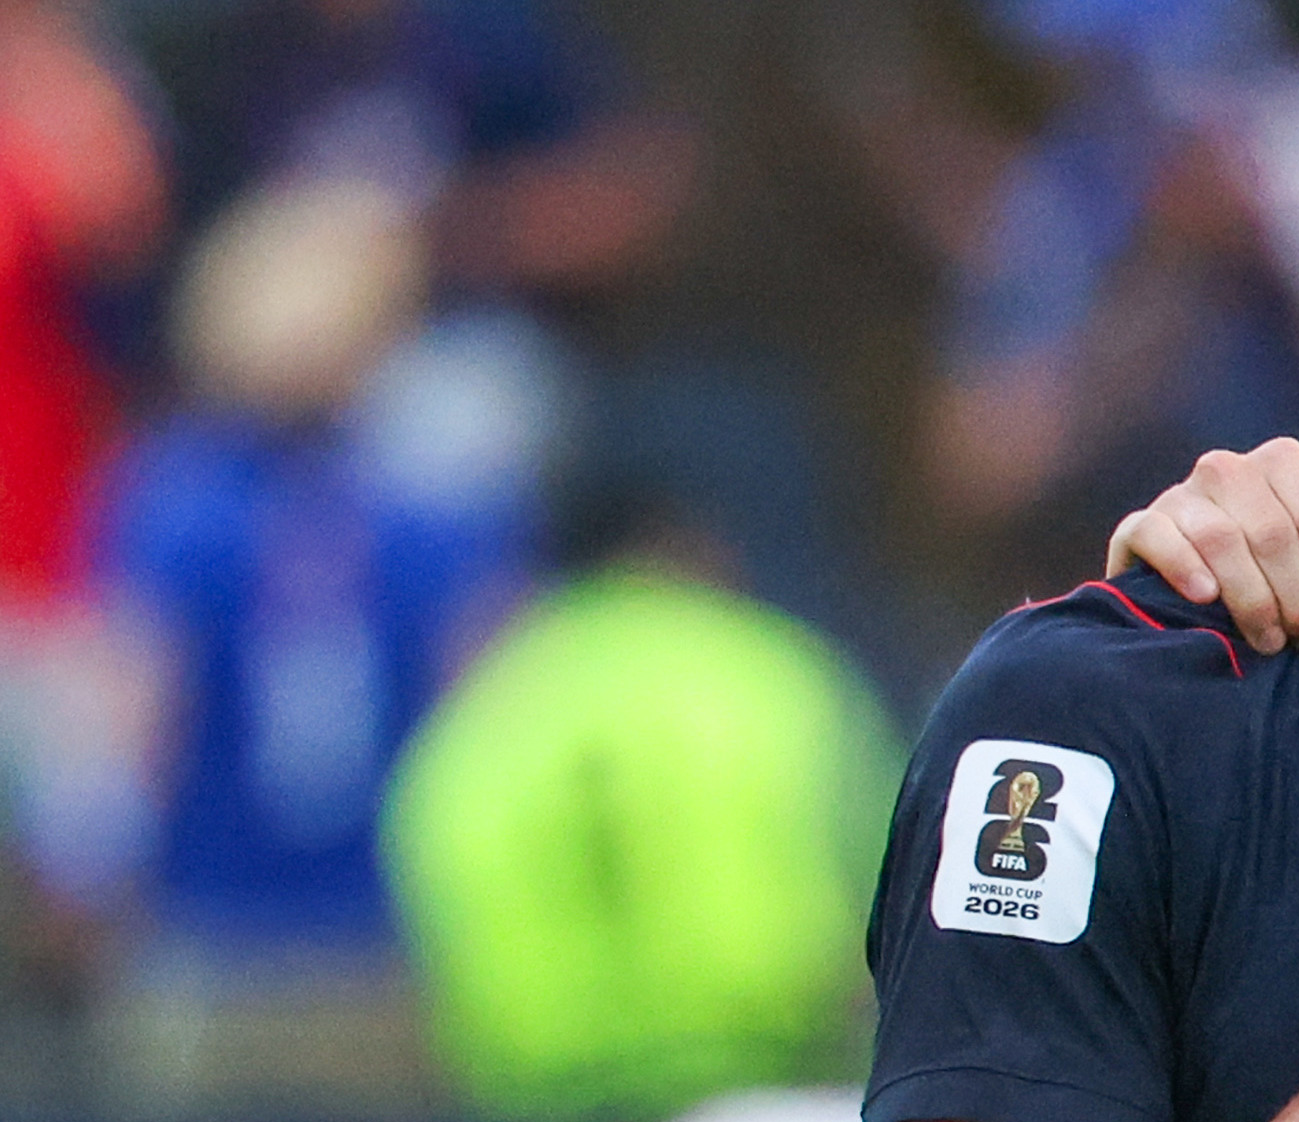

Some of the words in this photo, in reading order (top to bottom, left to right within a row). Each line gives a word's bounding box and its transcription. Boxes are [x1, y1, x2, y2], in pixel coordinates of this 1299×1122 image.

[992, 853, 1027, 871] FIFA
[969, 883, 1014, 898] WORLD
[1016, 887, 1043, 899] CUP
[964, 896, 1040, 920] 2026
